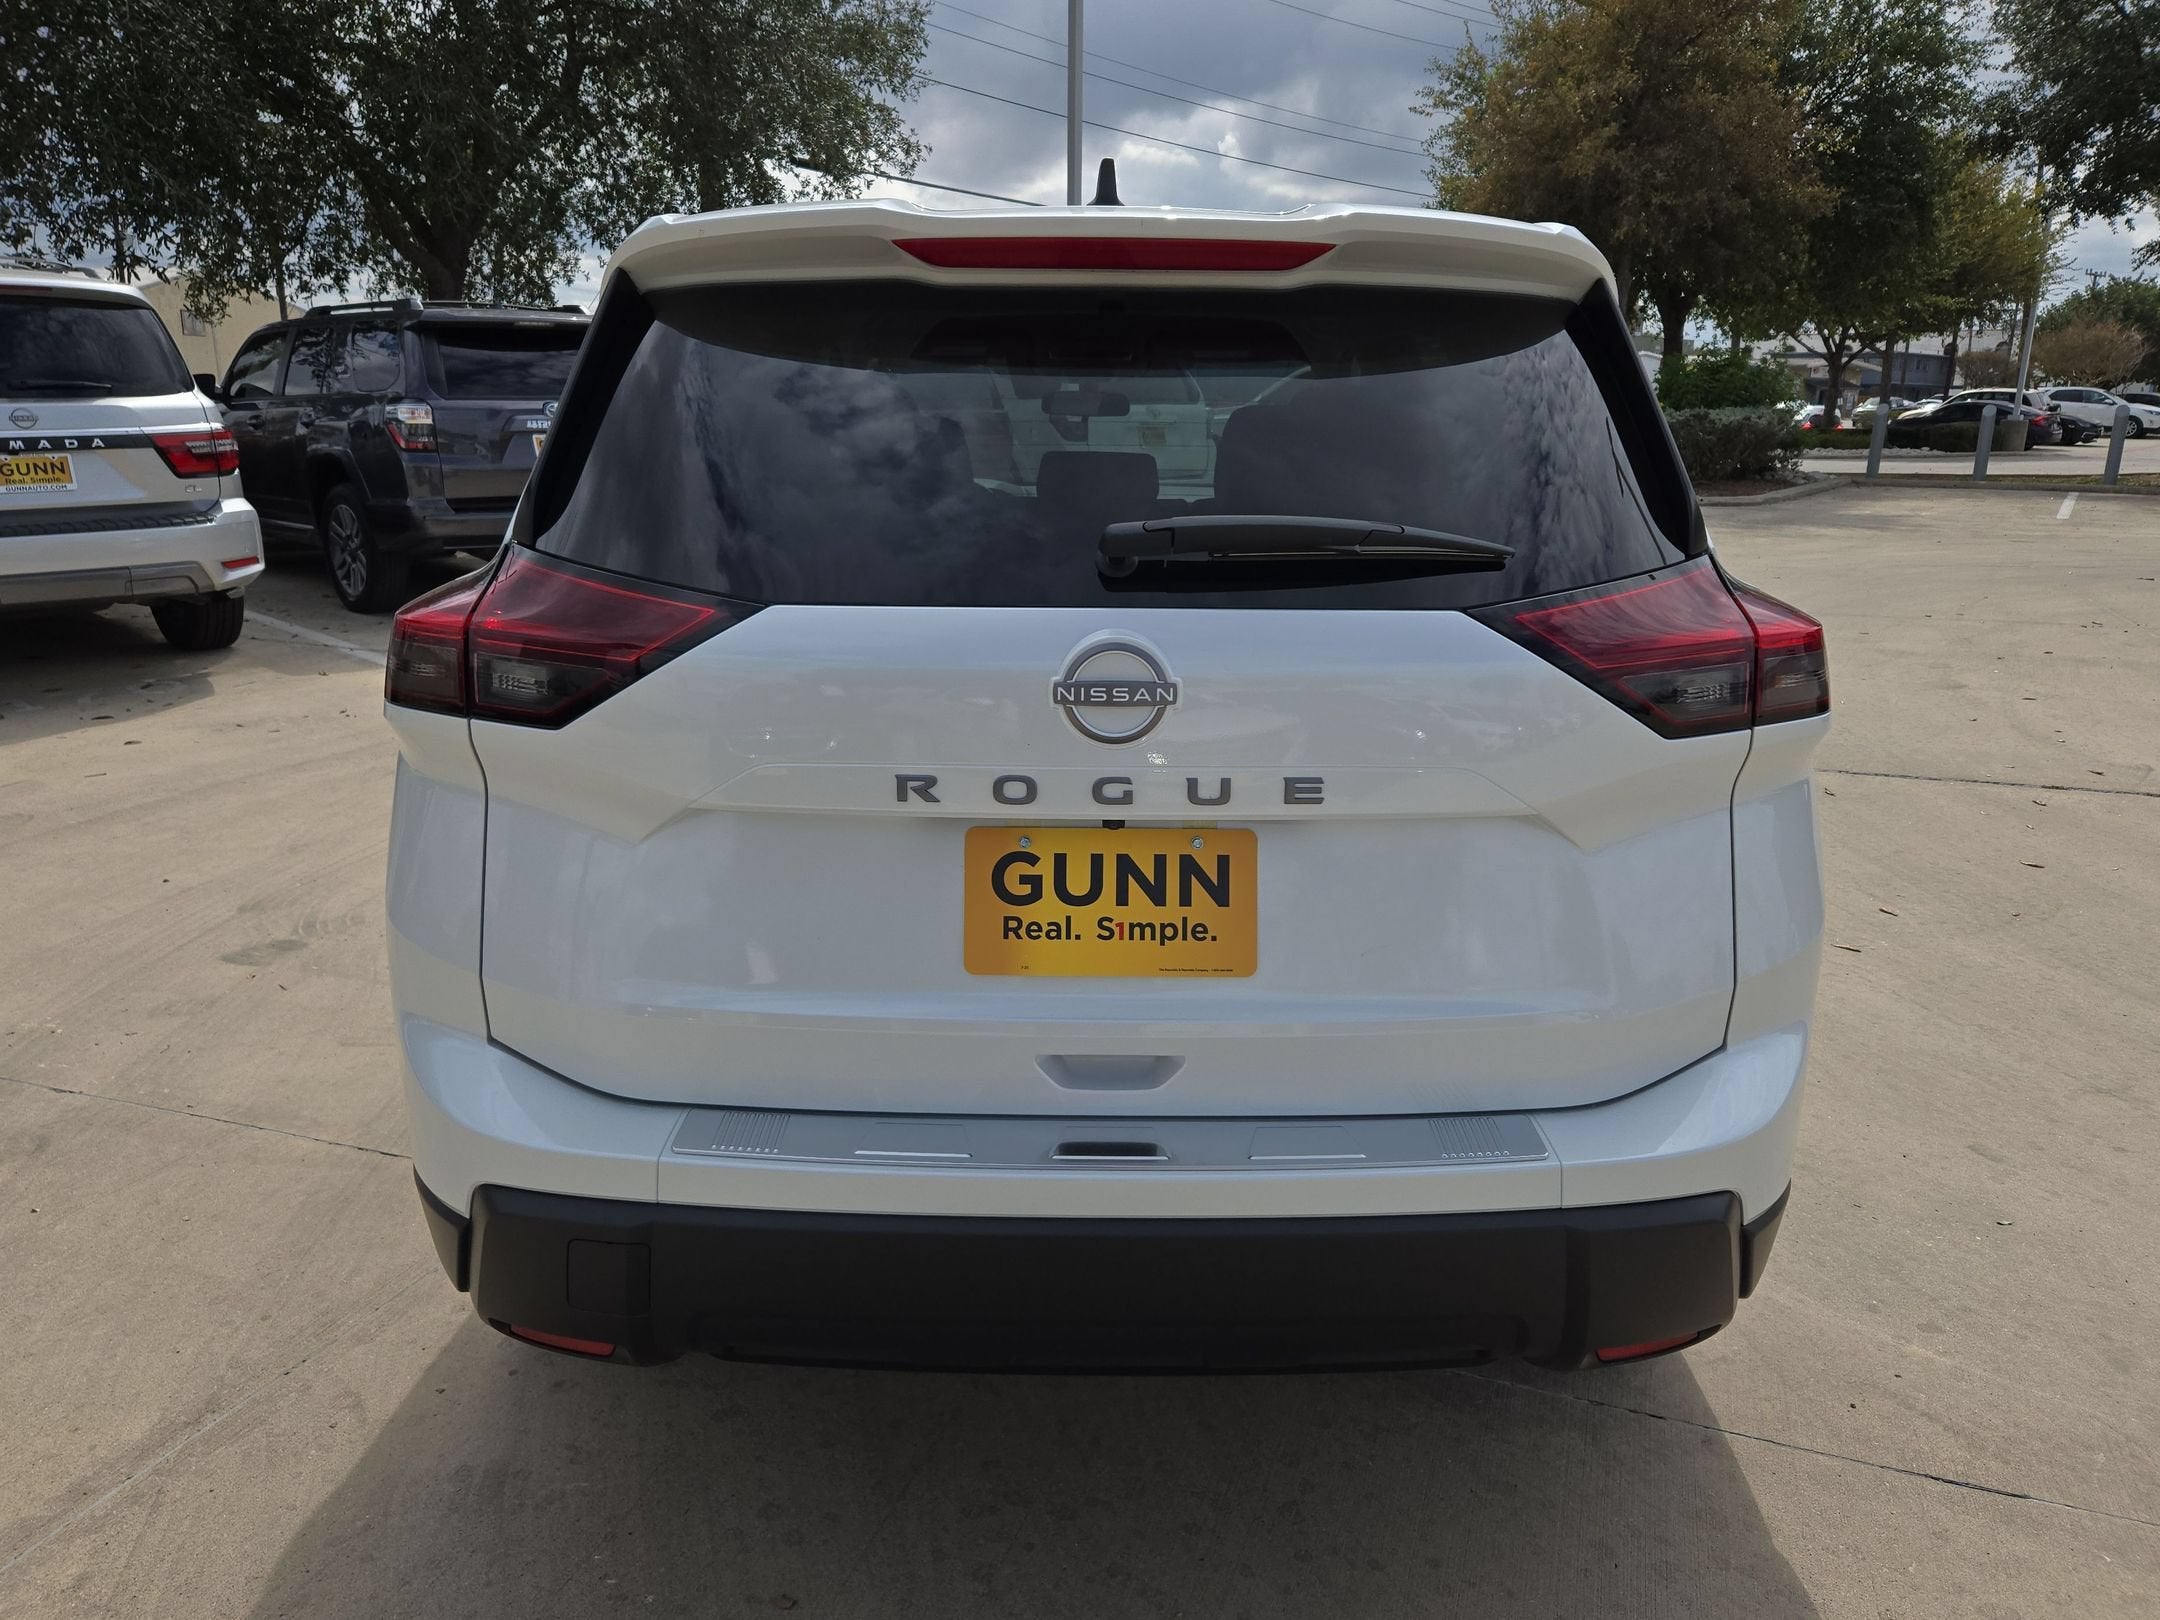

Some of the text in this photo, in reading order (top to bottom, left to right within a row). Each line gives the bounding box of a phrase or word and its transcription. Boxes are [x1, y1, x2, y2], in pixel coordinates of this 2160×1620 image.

[0, 461, 66, 477] GUNN
[5, 477, 28, 486] Real.
[6, 484, 68, 492] GUNNAUTO.COM
[1057, 687, 1174, 702] NISSAN
[895, 774, 1325, 805] ROGUE
[991, 850, 1230, 907] GUNN
[1003, 915, 1081, 941] Real.
